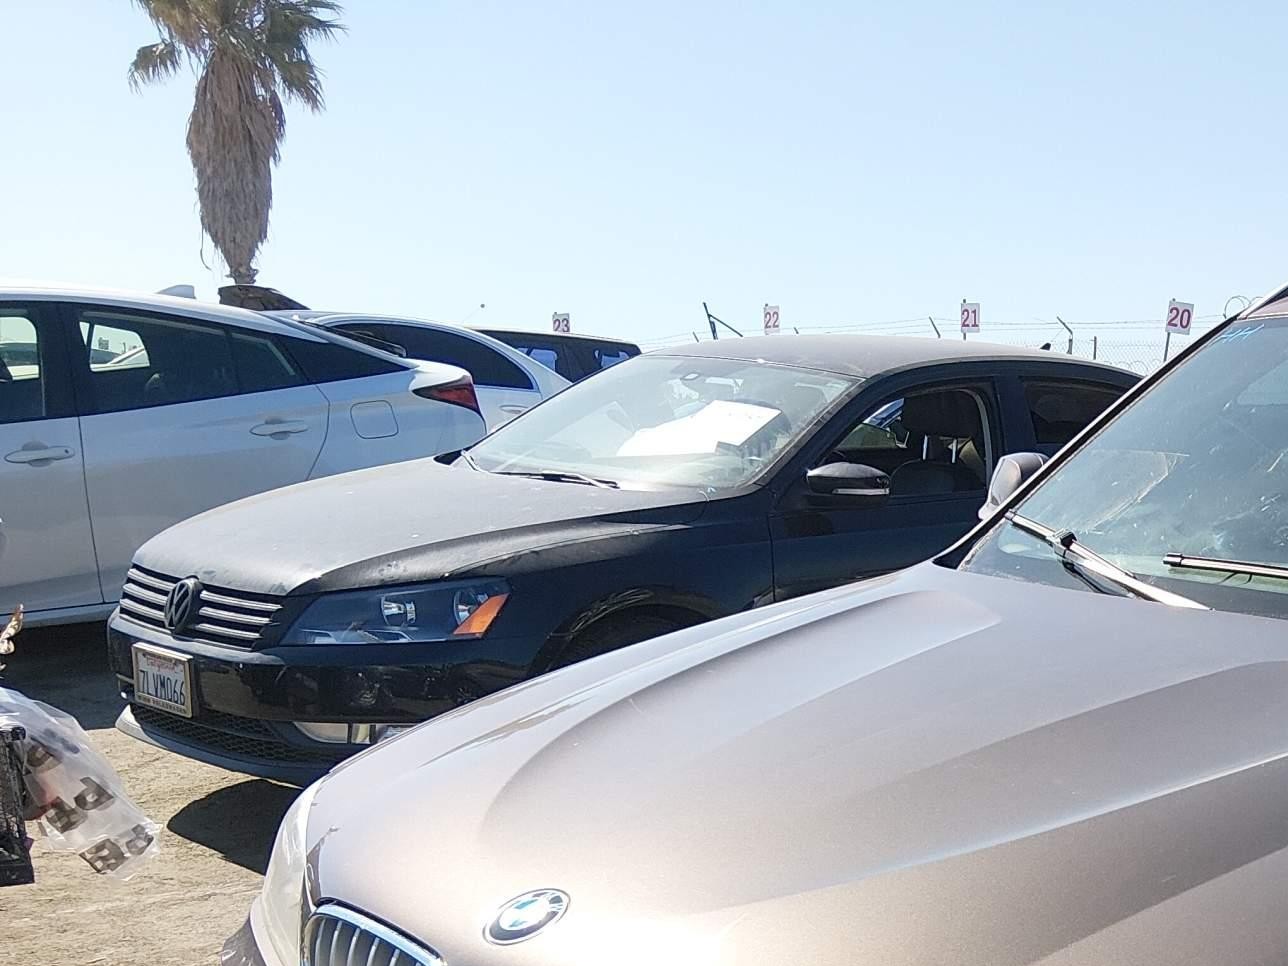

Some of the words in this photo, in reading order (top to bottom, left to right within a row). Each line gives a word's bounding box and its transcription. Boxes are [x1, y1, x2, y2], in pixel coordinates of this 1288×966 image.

[553, 318, 570, 333] 23
[764, 311, 780, 329] 22
[961, 308, 980, 328] 21
[1167, 306, 1192, 329] 20
